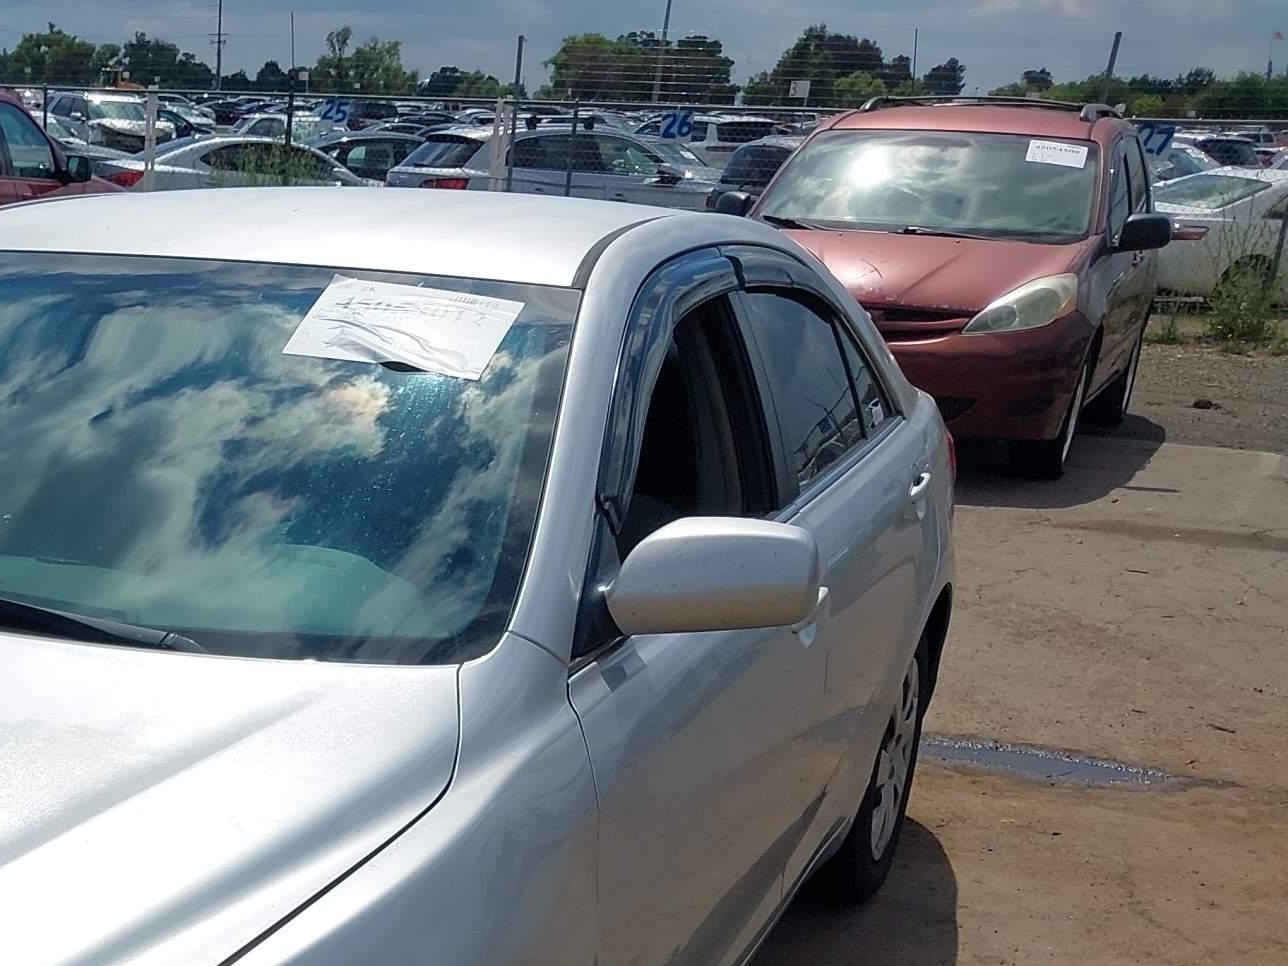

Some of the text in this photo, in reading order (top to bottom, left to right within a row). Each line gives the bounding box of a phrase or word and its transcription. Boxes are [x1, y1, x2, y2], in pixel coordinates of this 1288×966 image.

[320, 100, 349, 122] 25
[661, 109, 693, 138] 26
[1138, 123, 1175, 155] 27
